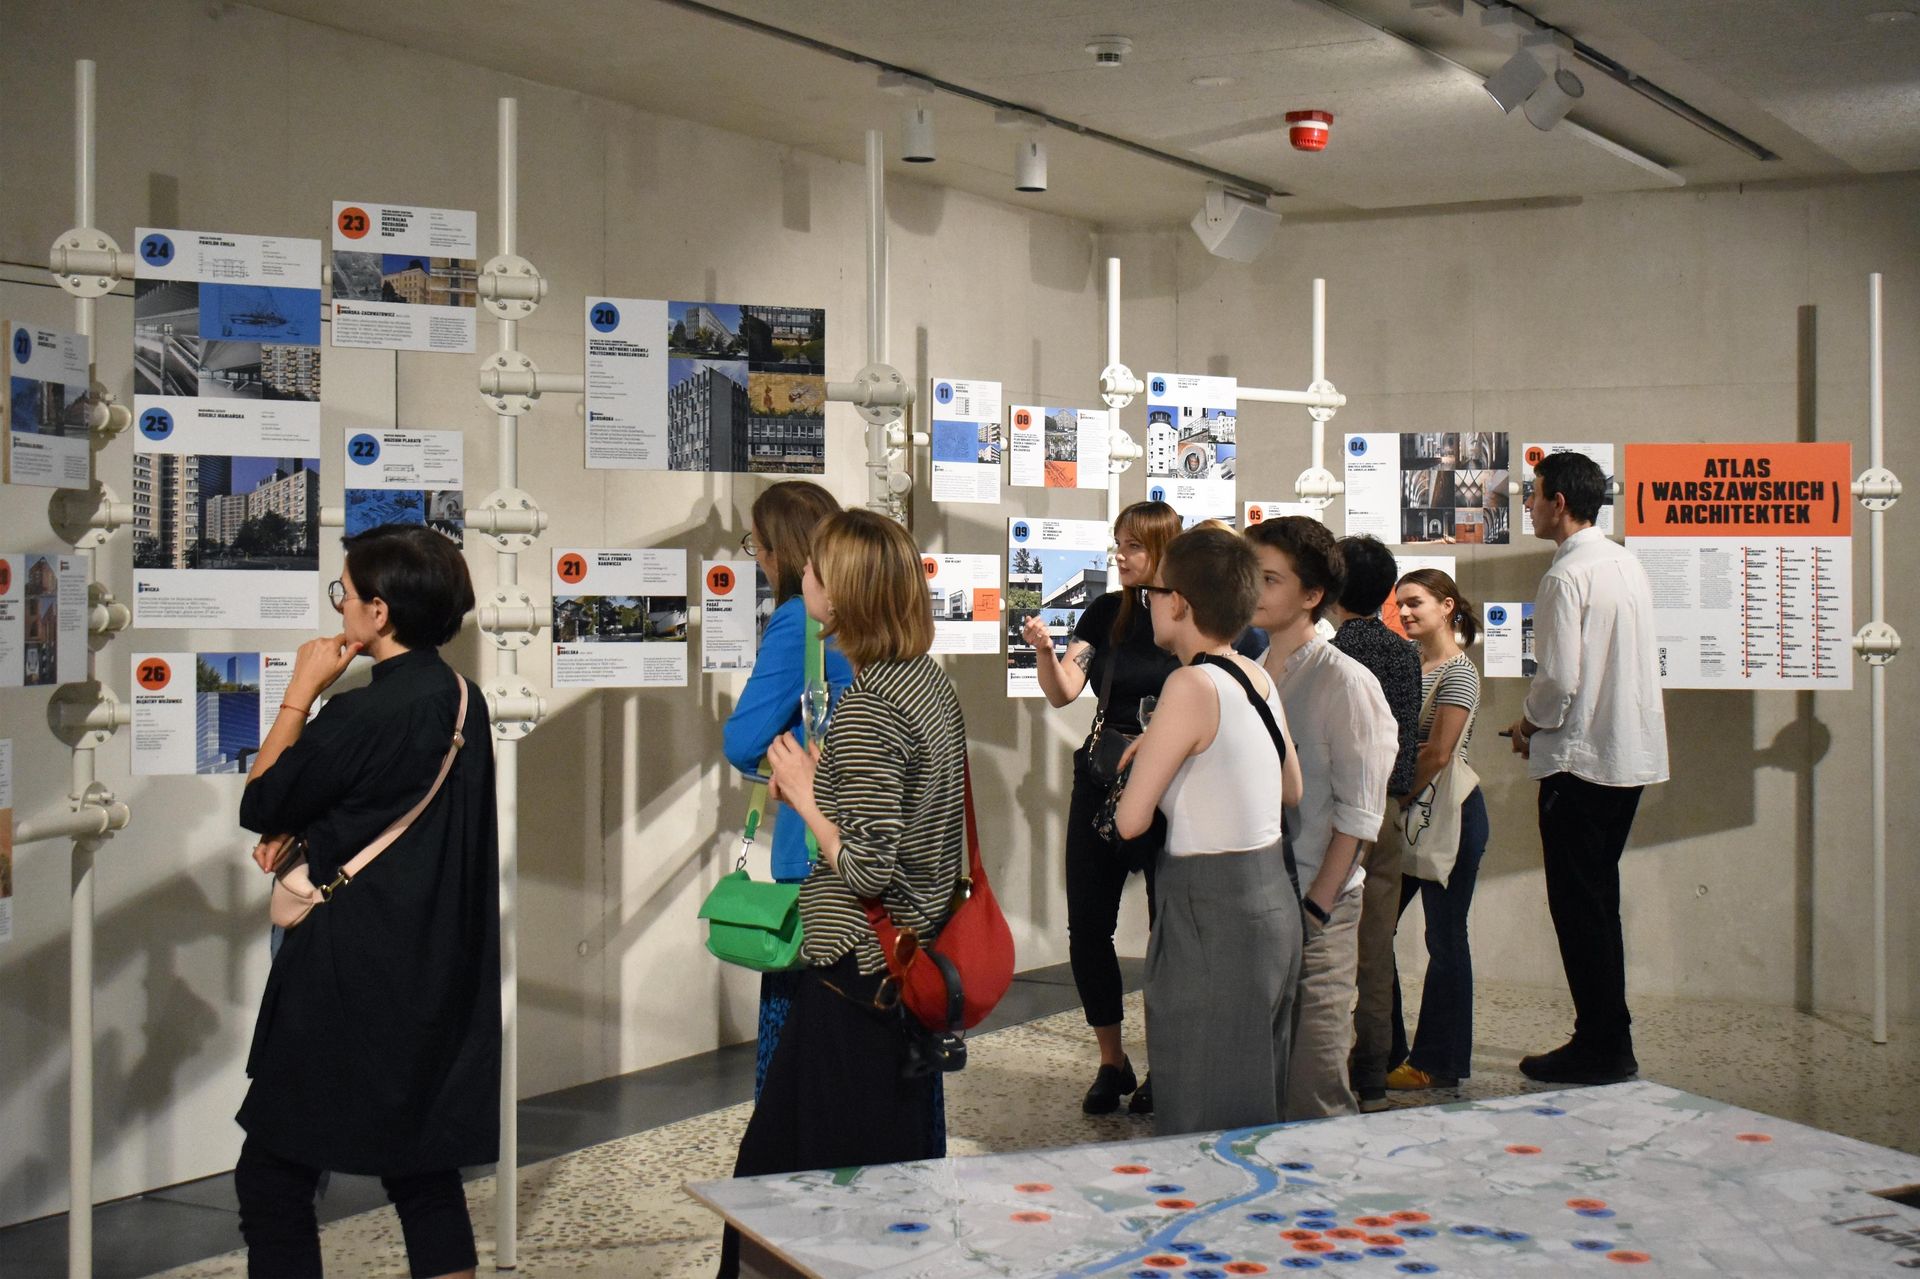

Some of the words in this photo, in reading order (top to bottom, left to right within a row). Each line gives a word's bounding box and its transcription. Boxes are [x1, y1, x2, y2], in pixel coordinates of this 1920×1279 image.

[343, 215, 365, 231] 23
[146, 242, 168, 258] 24
[595, 310, 615, 325] 20
[940, 387, 949, 399] 11
[1152, 381, 1164, 391] 06
[145, 416, 168, 433] 25
[1016, 414, 1029, 425] 08
[353, 441, 375, 457] 22
[1350, 442, 1364, 451] 04
[1529, 451, 1540, 461] 01
[1704, 458, 1771, 478] ATLAS
[1152, 490, 1163, 500] 07
[1652, 481, 1824, 501] WARSZAWSKICH
[1250, 510, 1261, 520] 05
[1665, 504, 1810, 524] ARCHITEKTEK
[1015, 526, 1027, 537] 09
[563, 560, 580, 576] 21
[924, 562, 934, 574] 10
[713, 573, 729, 587] 19
[1490, 610, 1504, 621] 02
[142, 665, 165, 682] 26
